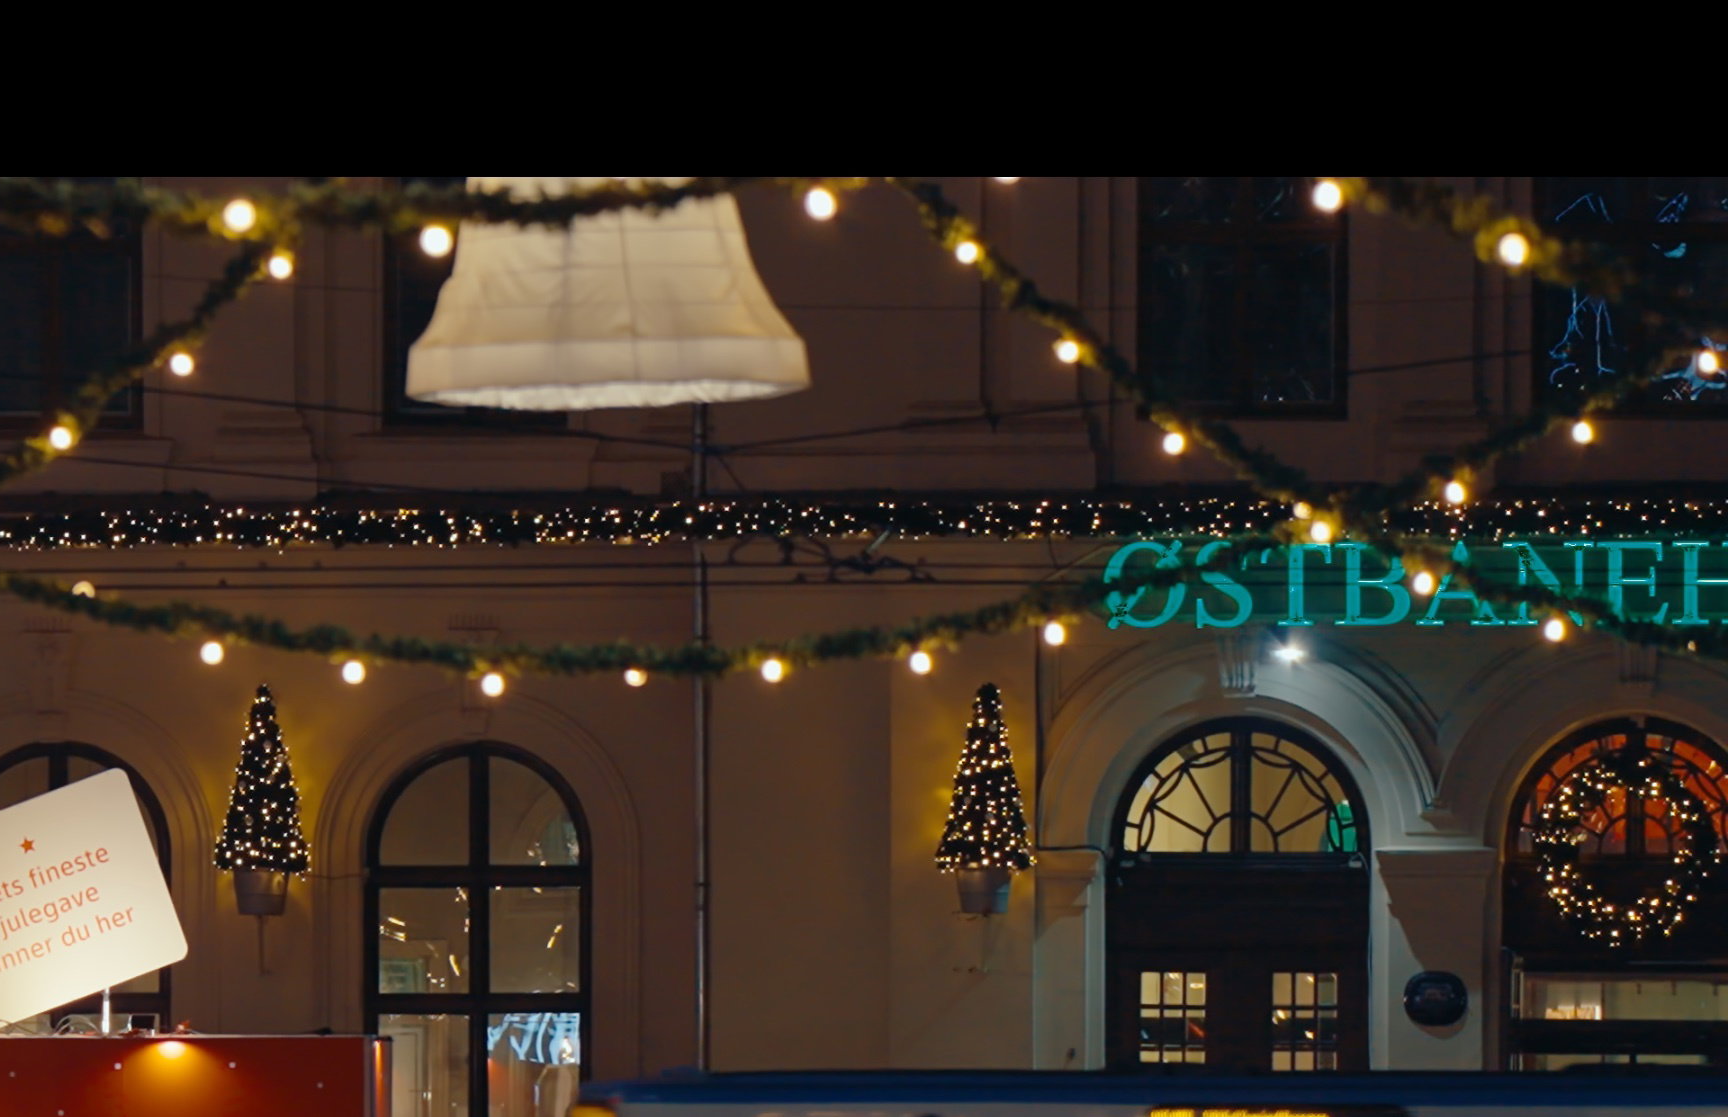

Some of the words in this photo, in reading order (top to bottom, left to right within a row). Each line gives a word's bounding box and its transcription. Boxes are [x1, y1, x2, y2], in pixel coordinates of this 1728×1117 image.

[29, 846, 110, 888] fineste
[61, 925, 92, 948] du
[95, 905, 135, 934] her
